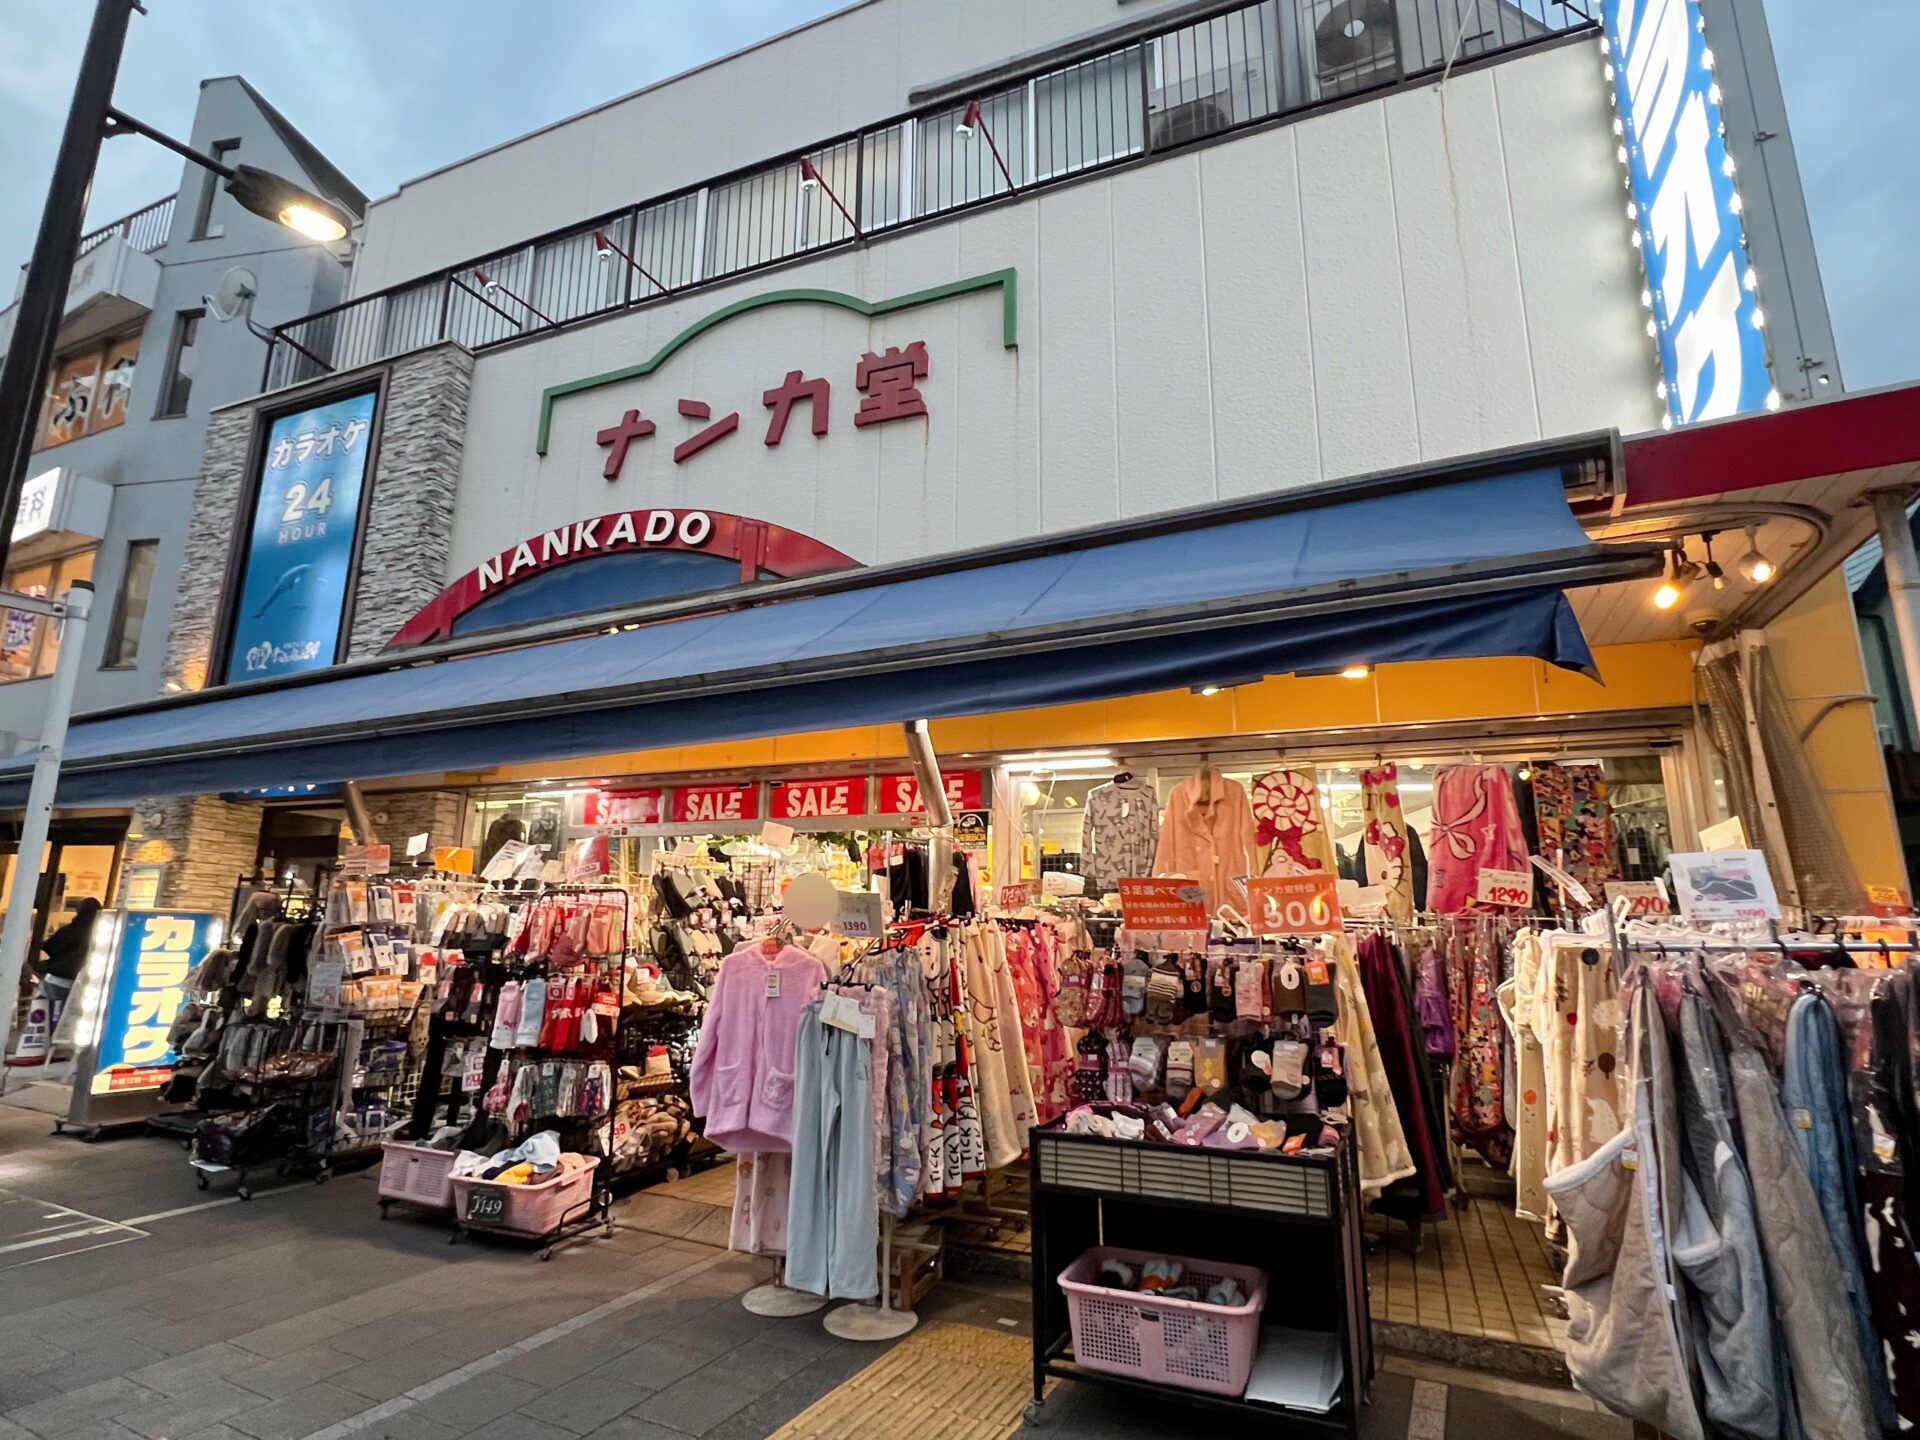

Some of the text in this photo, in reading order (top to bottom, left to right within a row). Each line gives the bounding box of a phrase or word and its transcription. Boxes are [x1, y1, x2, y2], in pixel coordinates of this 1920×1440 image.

[1616, 0, 1743, 425] ラオケ
[596, 340, 931, 482] ナンカ堂
[271, 419, 368, 469] カラオケ
[282, 476, 332, 523] 24
[278, 522, 327, 544] HOUR
[476, 509, 712, 593] NANKADO
[685, 791, 743, 822] SALE
[786, 786, 849, 818] SALE
[896, 779, 964, 813] SAE
[1489, 886, 1528, 905] 1290
[843, 921, 867, 931] 1390
[948, 1143, 960, 1180] TICK
[961, 1127, 972, 1164] TICK
[929, 1147, 942, 1184] TICK
